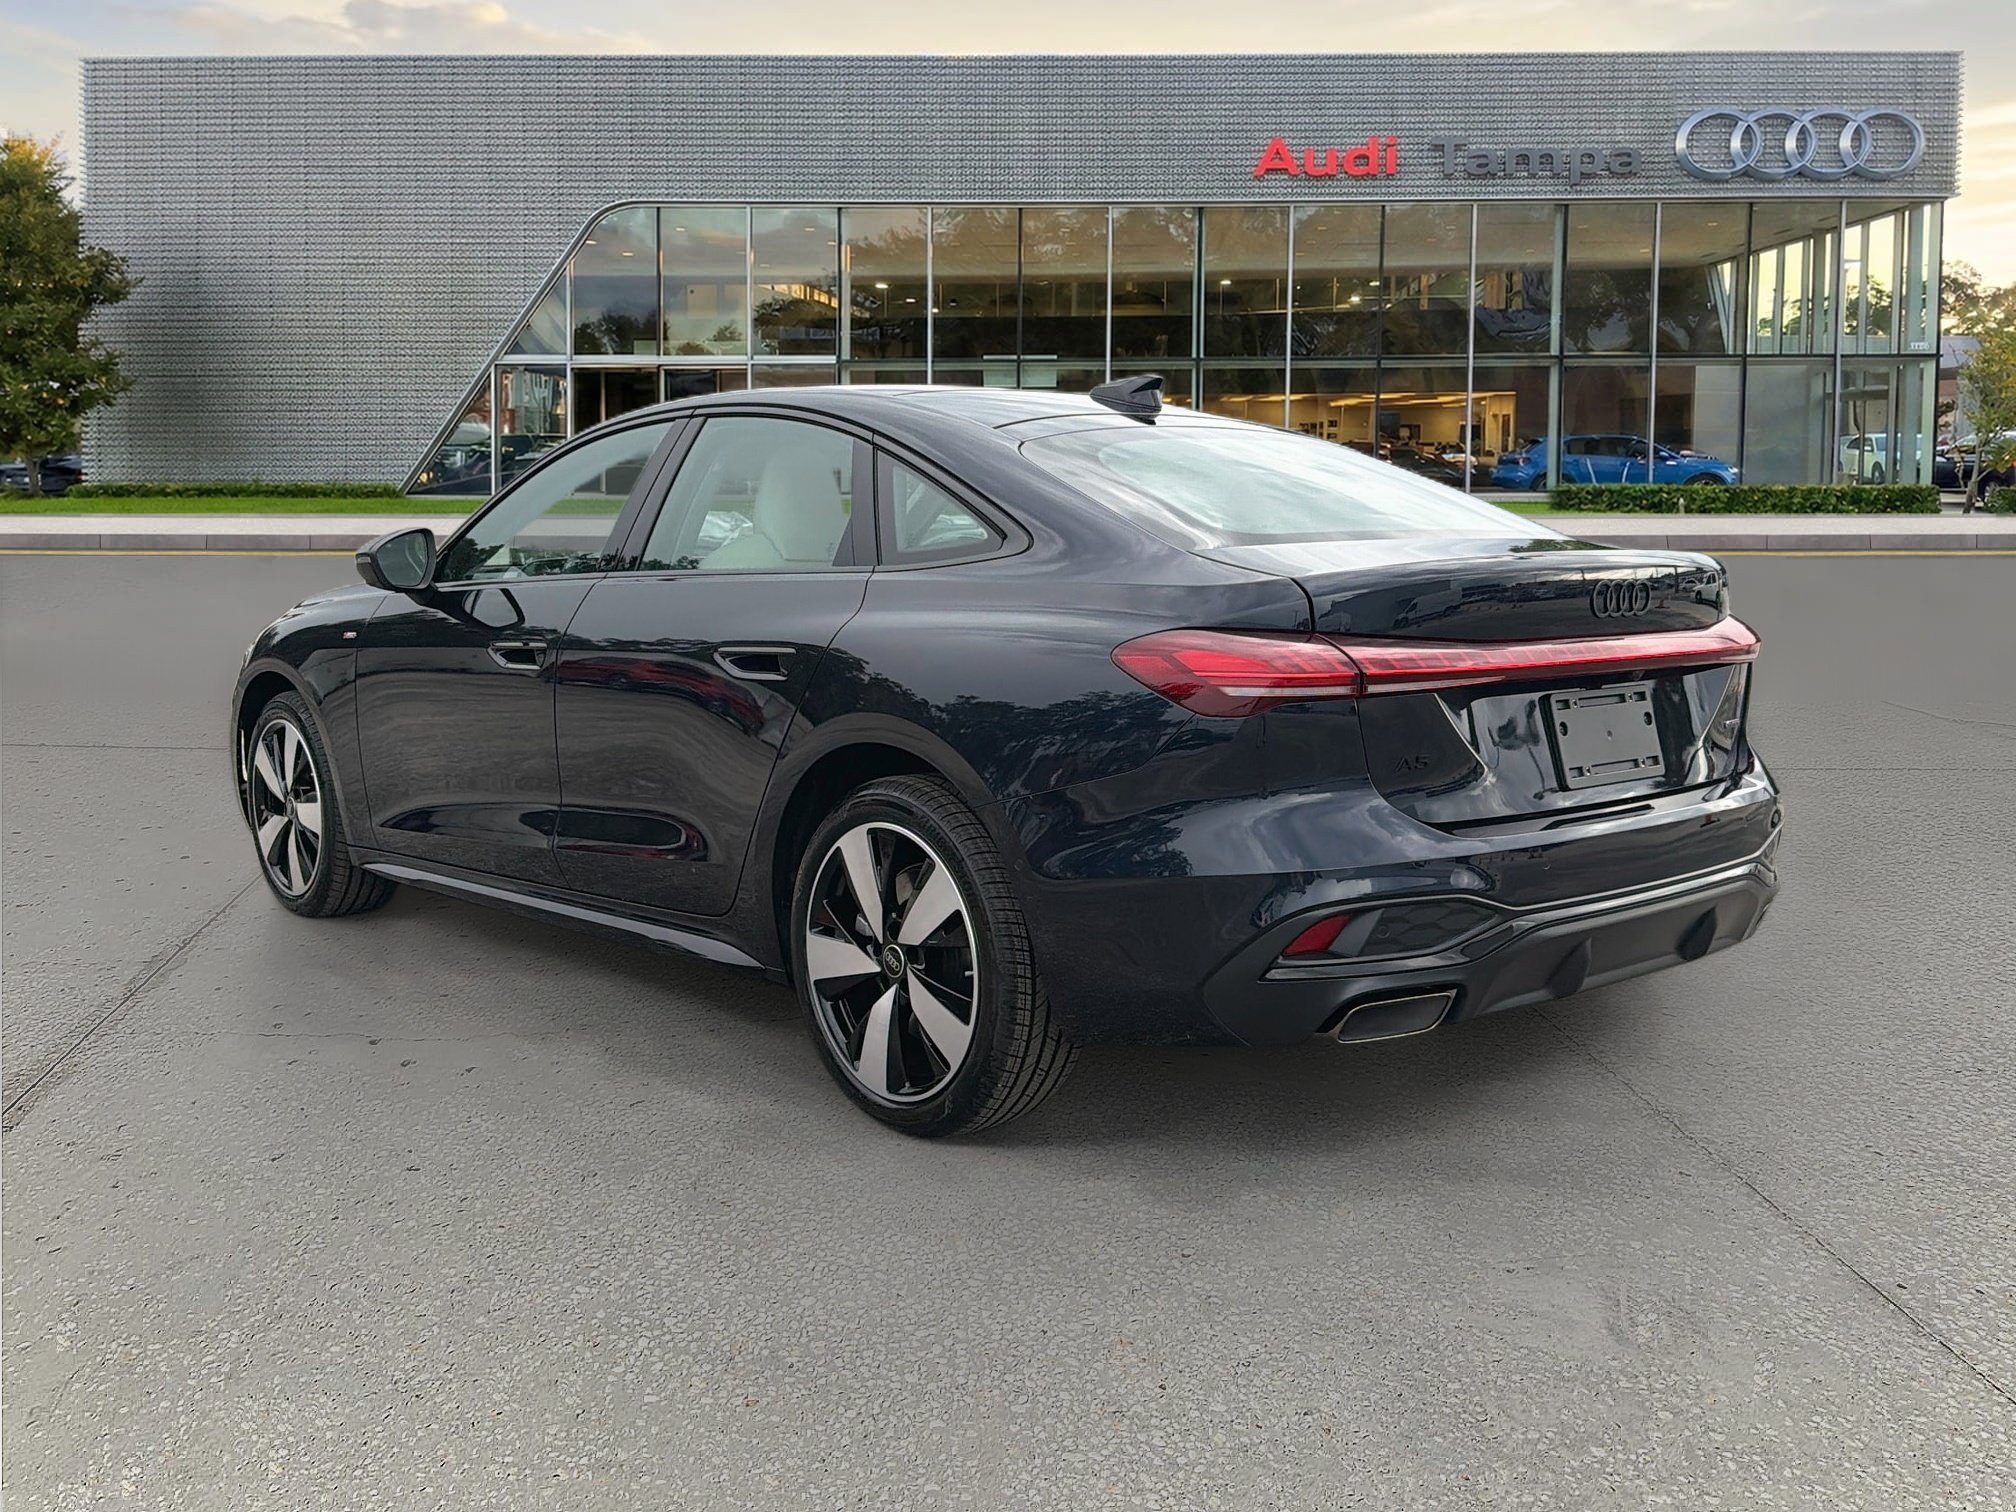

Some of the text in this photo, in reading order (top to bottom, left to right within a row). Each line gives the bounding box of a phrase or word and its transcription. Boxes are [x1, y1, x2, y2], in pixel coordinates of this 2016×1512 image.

[1253, 135, 1643, 186] Audi Tampa
[1393, 753, 1431, 774] A5
